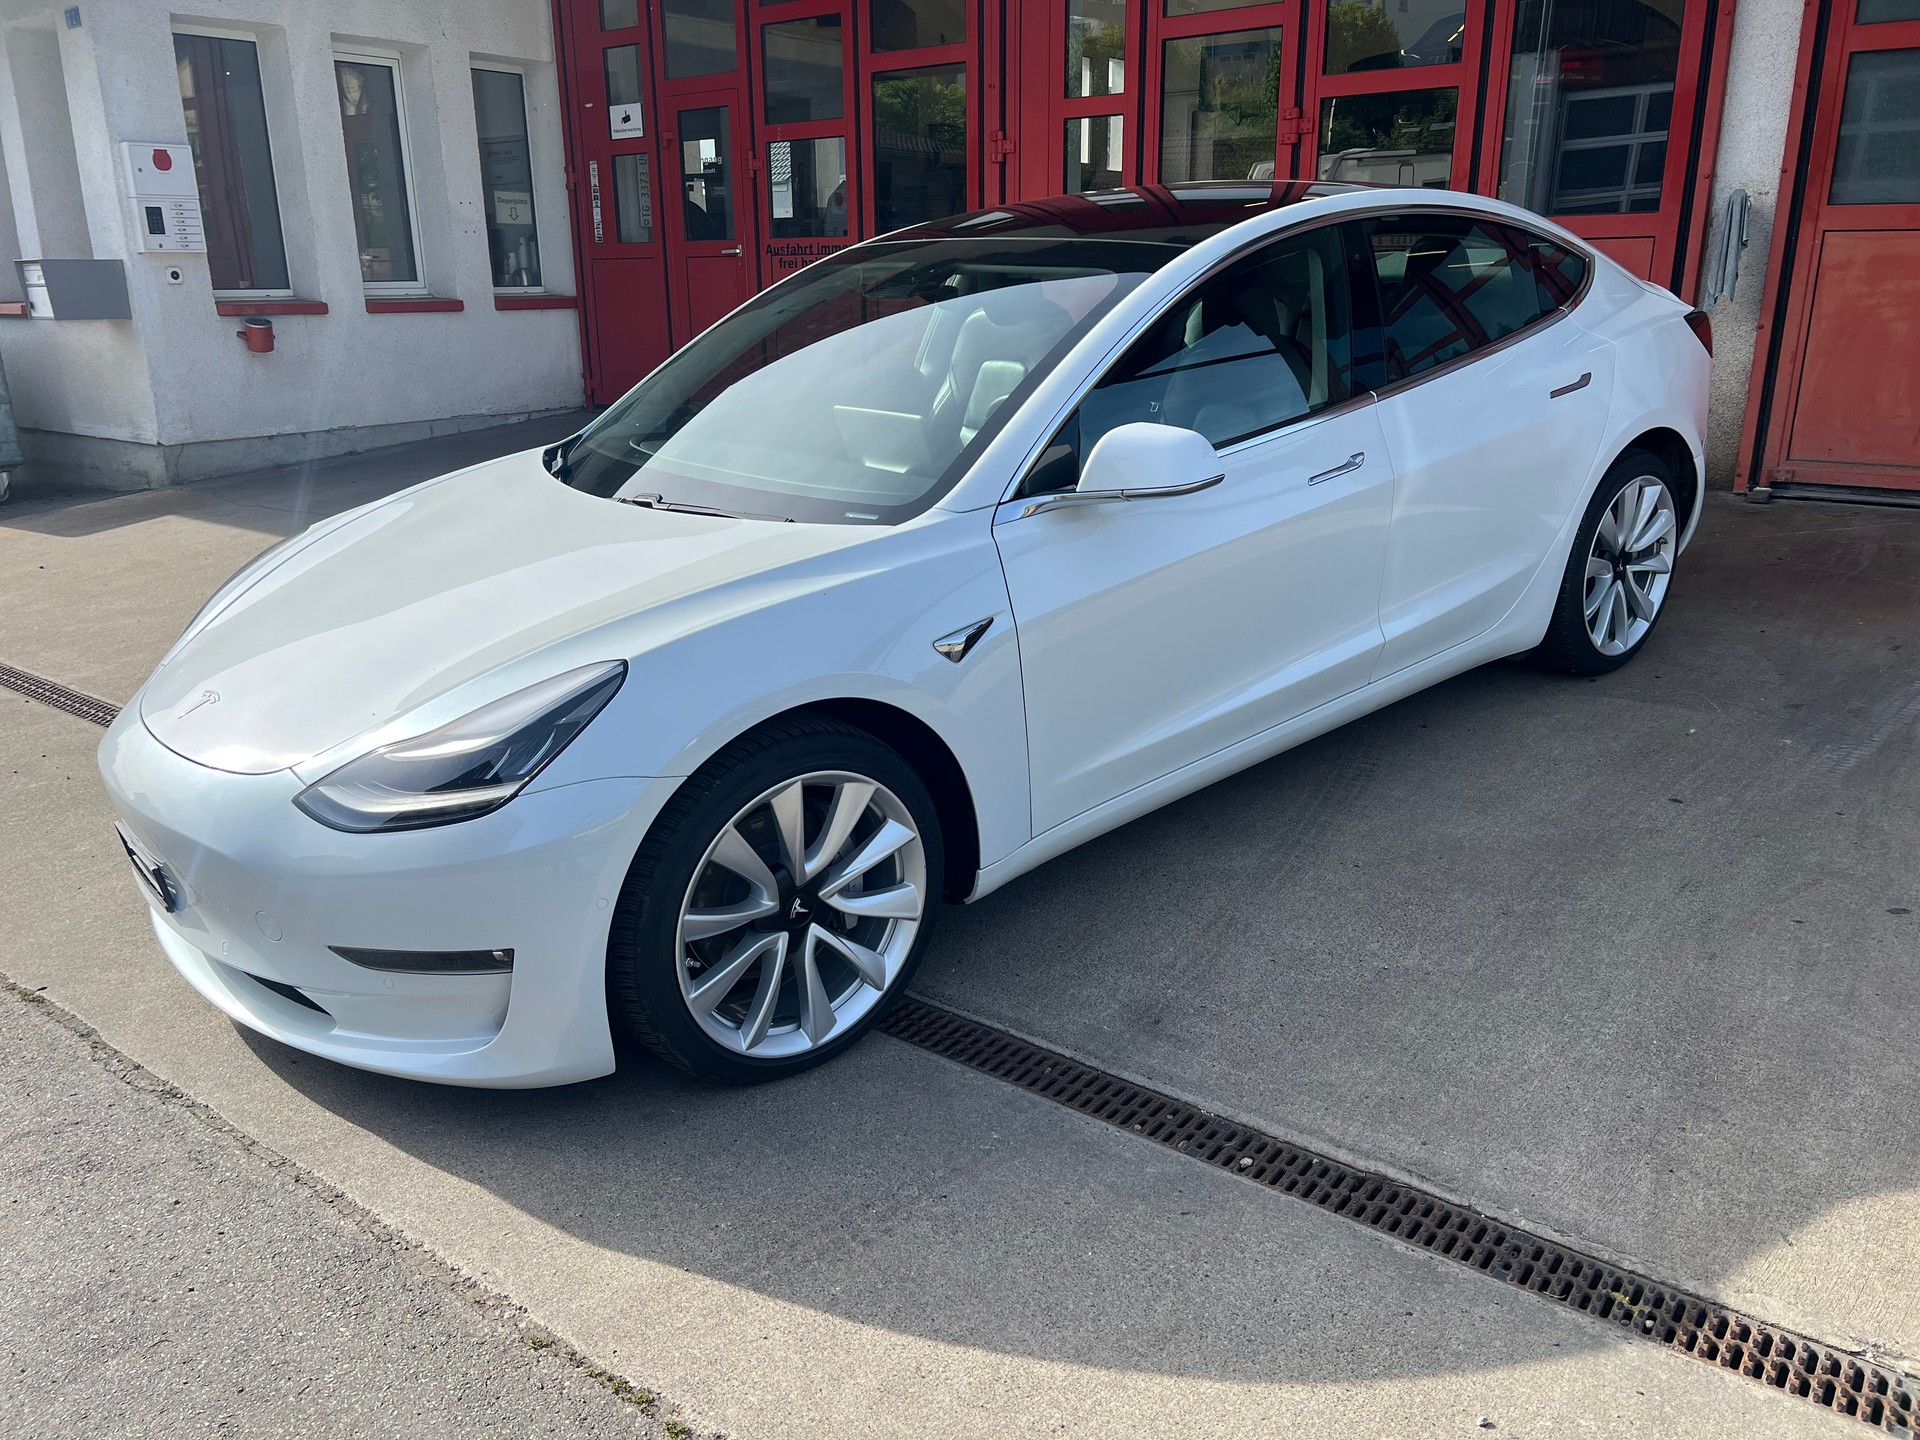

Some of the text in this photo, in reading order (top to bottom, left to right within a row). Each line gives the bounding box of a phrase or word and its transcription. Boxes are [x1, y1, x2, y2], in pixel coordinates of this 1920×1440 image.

[766, 242, 851, 256] Ausfahrt imme
[779, 257, 798, 269] frei
